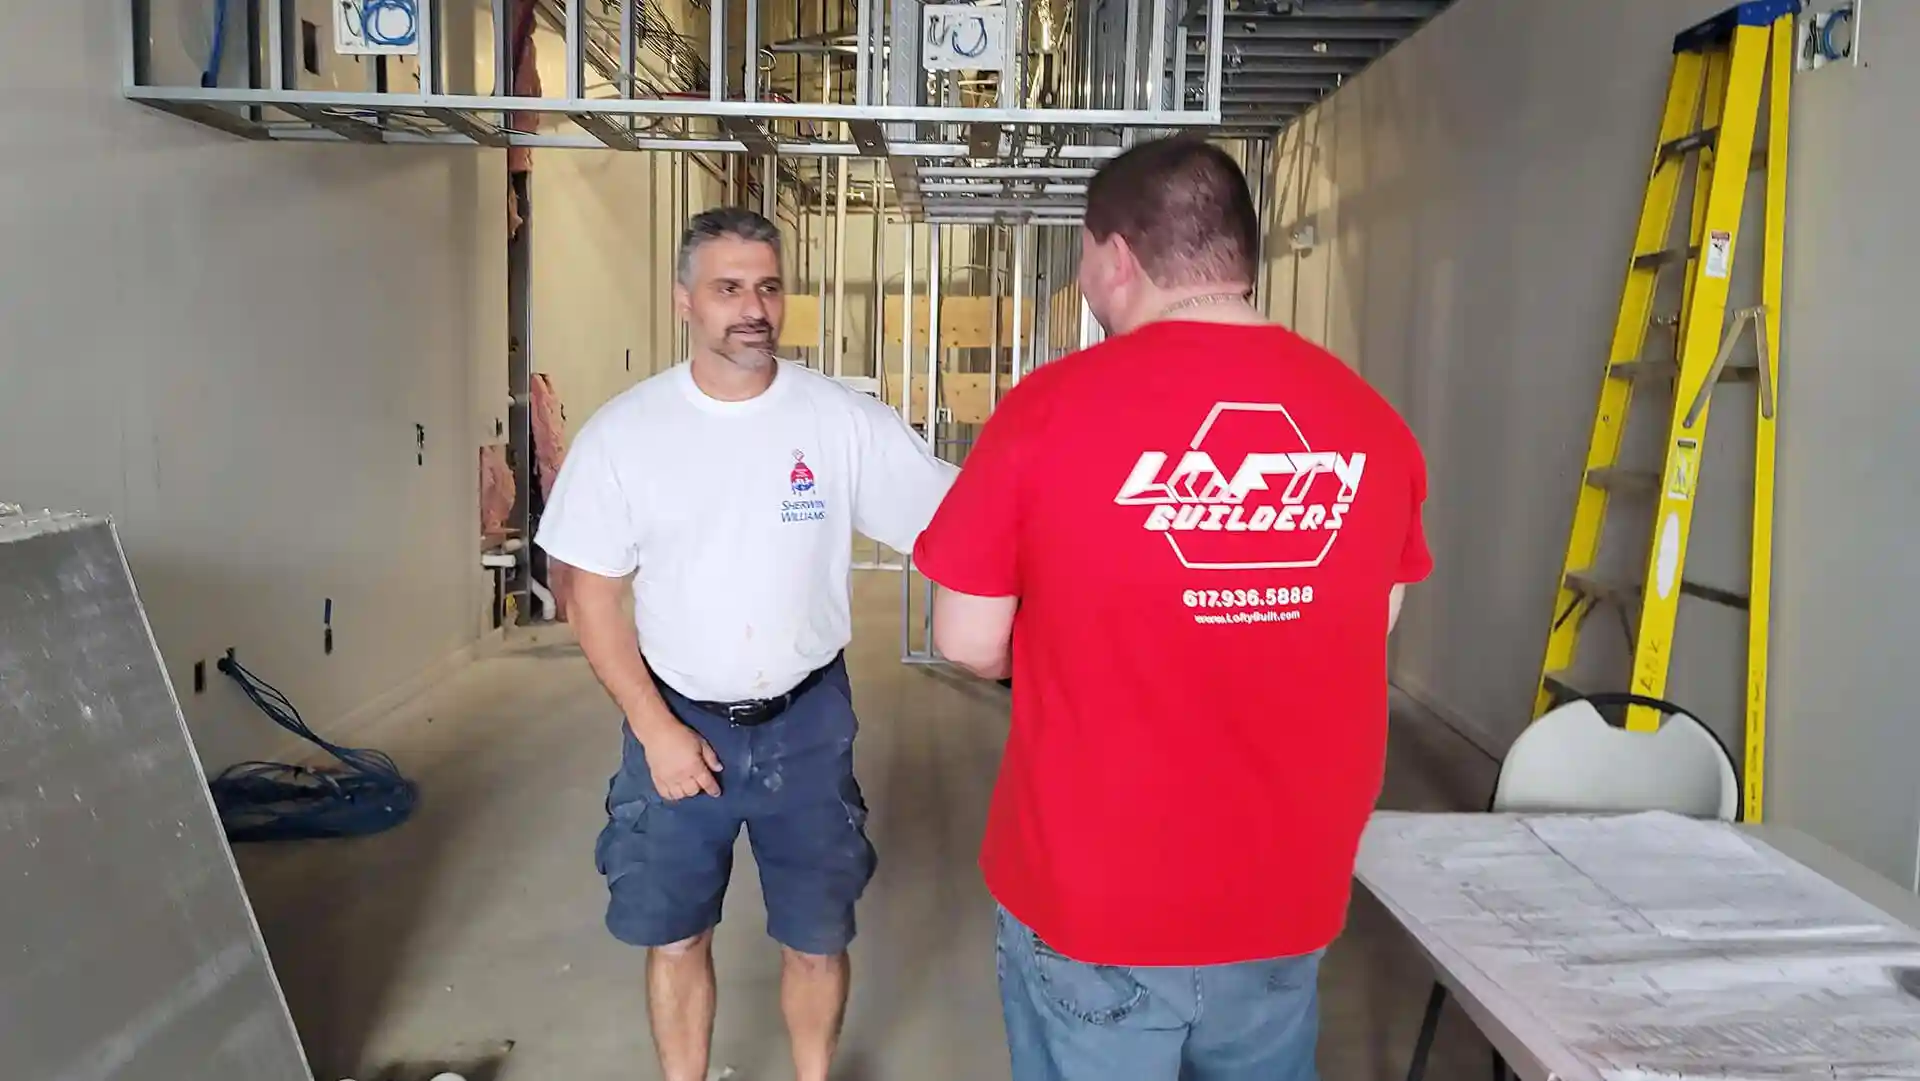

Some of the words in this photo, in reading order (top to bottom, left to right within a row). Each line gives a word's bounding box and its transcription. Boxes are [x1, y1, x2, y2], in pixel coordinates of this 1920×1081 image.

[1114, 451, 1366, 504] LOFTY
[1143, 503, 1349, 531] BUILDERS
[1183, 586, 1314, 607] 617.936.5888
